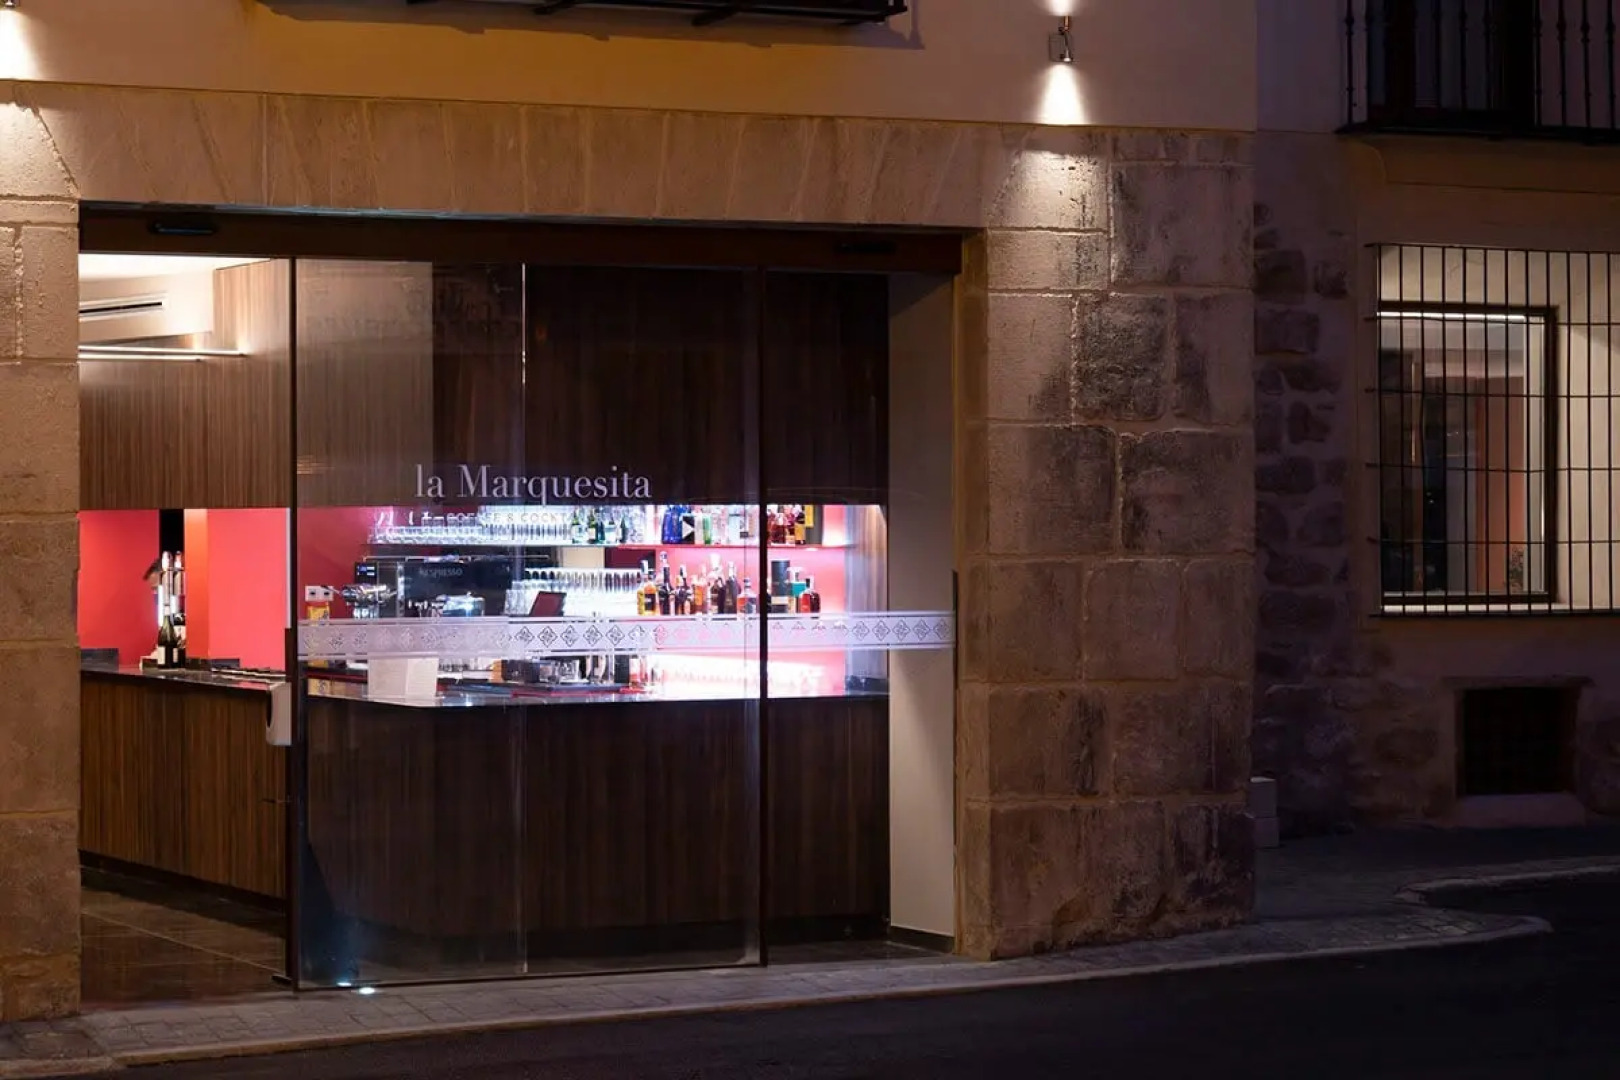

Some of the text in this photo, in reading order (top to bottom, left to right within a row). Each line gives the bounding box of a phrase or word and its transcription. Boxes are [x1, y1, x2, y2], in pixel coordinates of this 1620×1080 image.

[415, 464, 652, 508] la Marquesita
[446, 512, 502, 522] COFEE
